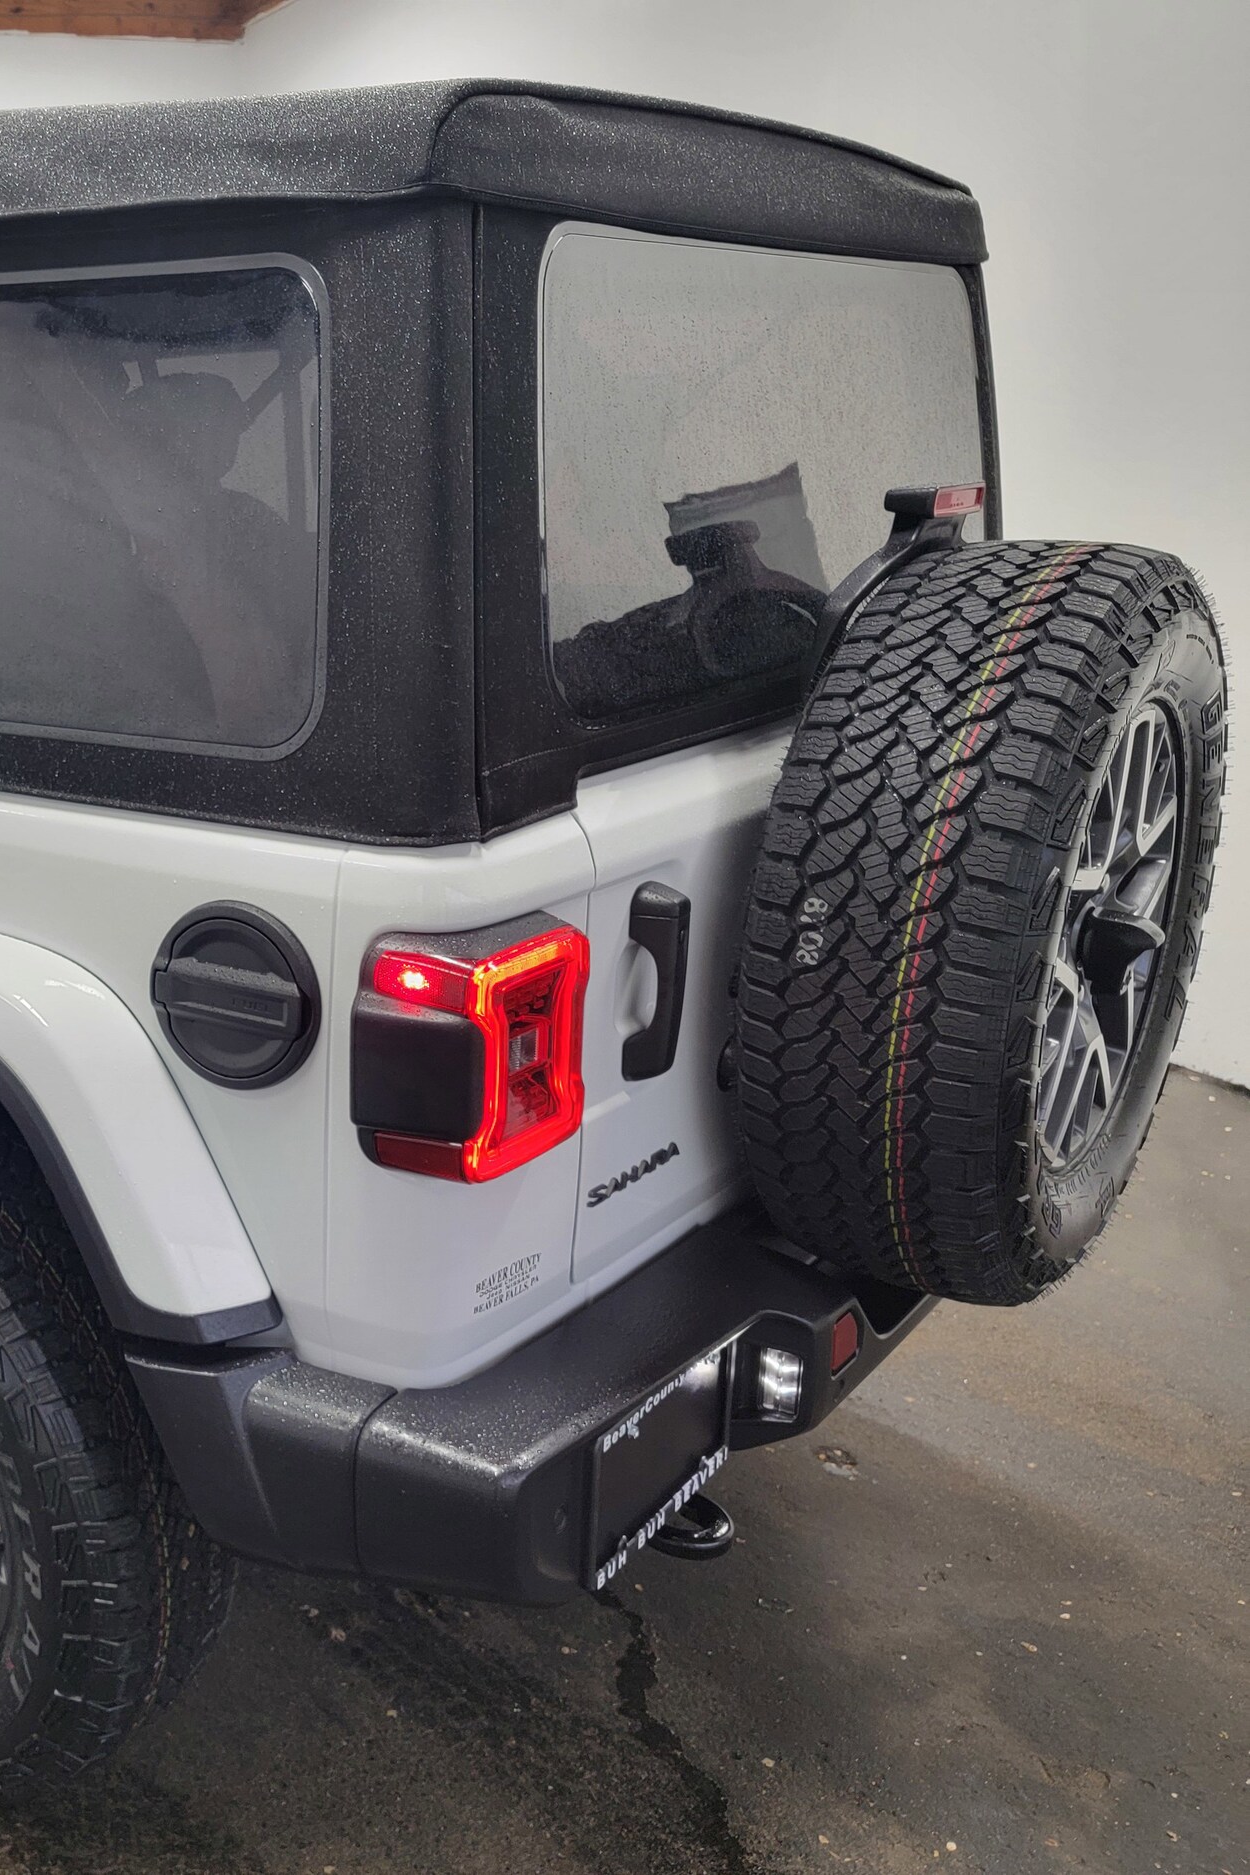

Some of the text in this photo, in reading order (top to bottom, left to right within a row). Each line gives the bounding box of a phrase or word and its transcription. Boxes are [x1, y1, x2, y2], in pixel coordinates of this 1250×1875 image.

[1163, 690, 1224, 1022] GENERAL
[586, 1141, 680, 1208] SAHARA
[473, 1293, 504, 1314] BEAVER
[475, 1252, 542, 1293] BEAVER COUNTY
[596, 1549, 627, 1590] BUH
[637, 1509, 666, 1550] BUH
